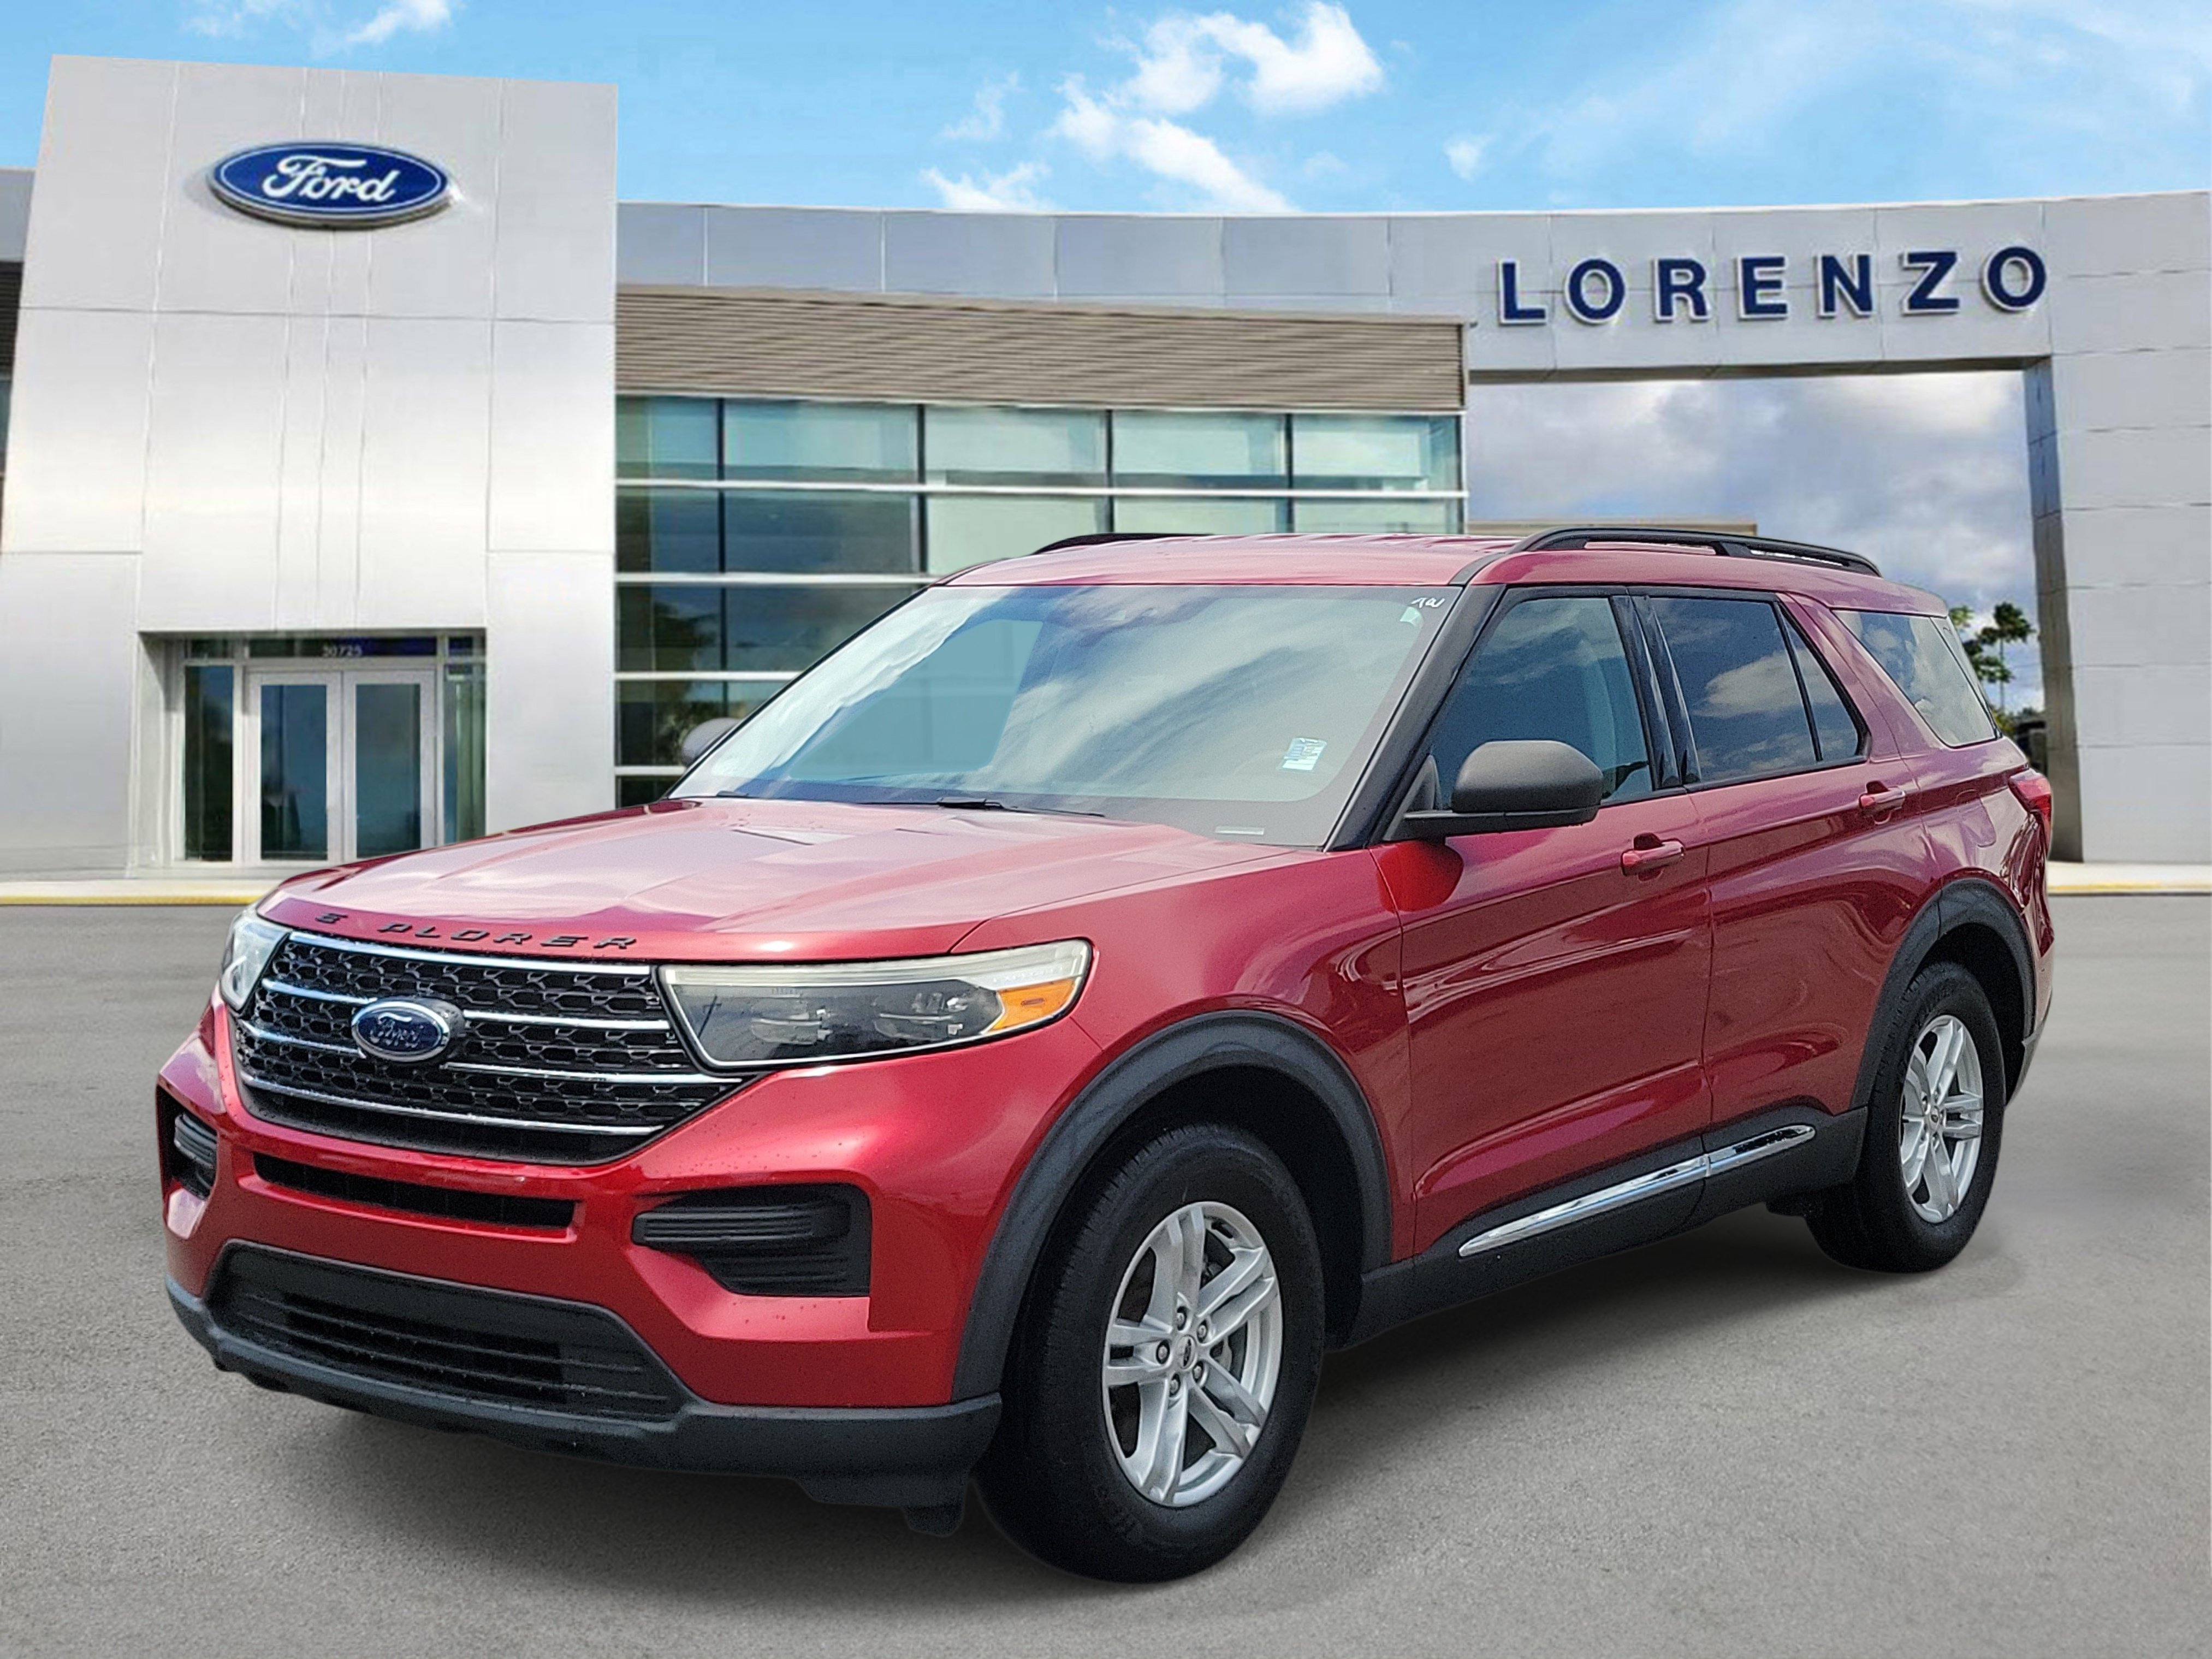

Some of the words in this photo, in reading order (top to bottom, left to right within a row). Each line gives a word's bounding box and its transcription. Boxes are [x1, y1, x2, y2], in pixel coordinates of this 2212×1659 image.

[262, 154, 400, 202] Ford
[1498, 246, 2047, 325] LORENZO
[315, 911, 638, 950] EPLORER
